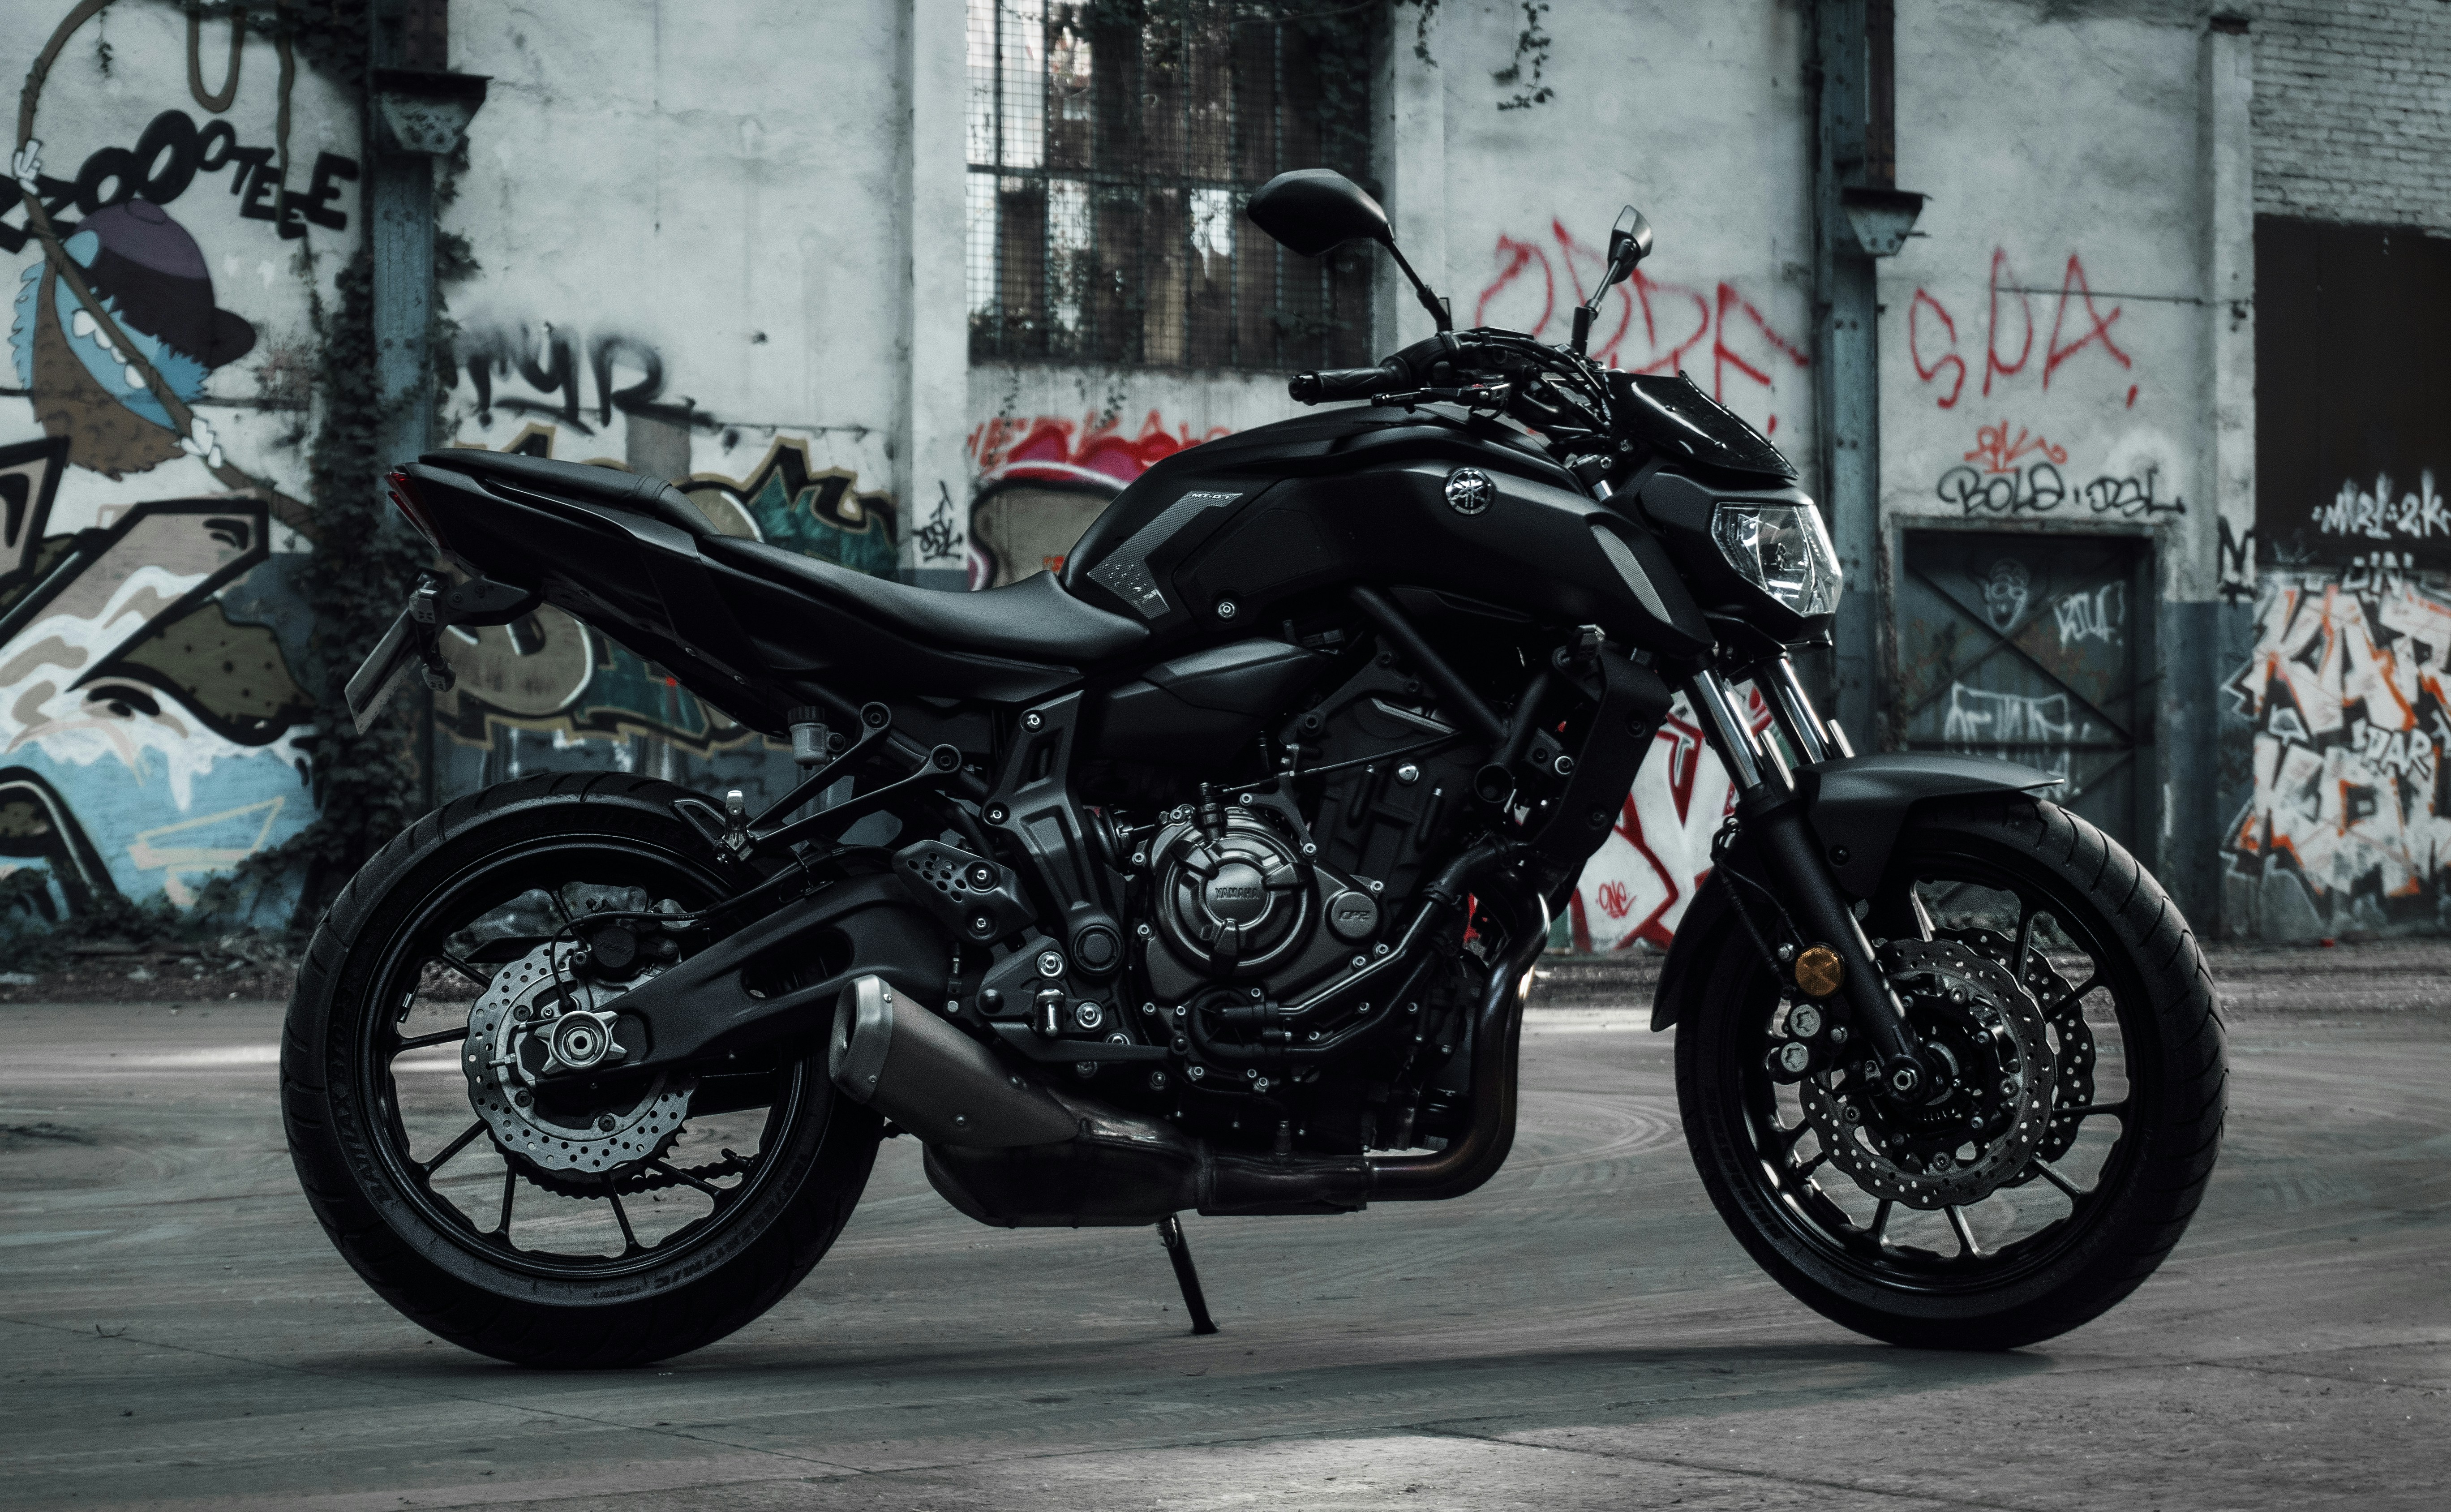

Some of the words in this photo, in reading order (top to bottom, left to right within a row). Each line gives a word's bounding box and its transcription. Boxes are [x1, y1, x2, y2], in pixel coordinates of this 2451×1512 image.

[1215, 887, 1259, 900] YAMAHA
[1339, 911, 1371, 921] CP2
[332, 1093, 393, 1205] BATTLAX
